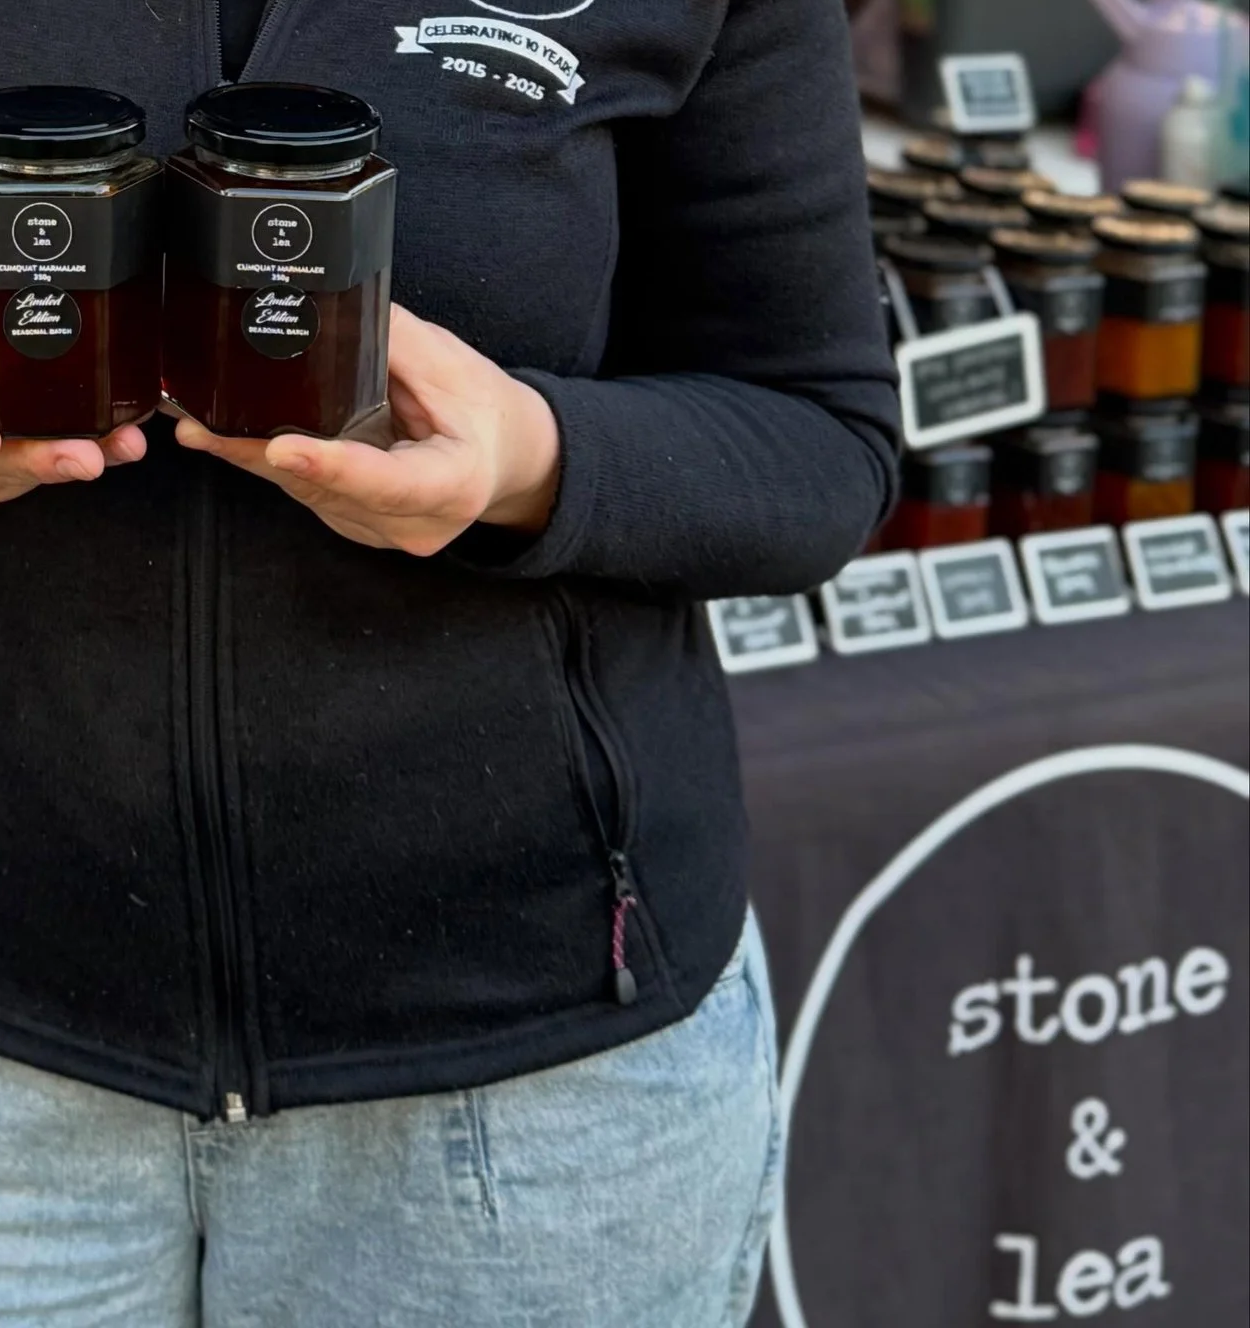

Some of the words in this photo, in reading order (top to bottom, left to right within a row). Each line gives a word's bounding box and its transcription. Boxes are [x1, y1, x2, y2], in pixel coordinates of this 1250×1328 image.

[424, 24, 523, 47] CELEBRATING
[524, 37, 540, 53] 10
[542, 44, 574, 77] YEARS
[441, 56, 488, 79] 2015
[504, 72, 546, 101] 2025
[27, 217, 58, 227] stone
[267, 217, 298, 228] stone
[33, 237, 52, 247] lea
[272, 237, 291, 247] lea
[38, 264, 87, 273] MARMALADE
[236, 263, 276, 273] CUMQUAT
[276, 265, 325, 275] MARMALADE
[15, 293, 66, 310] Limited
[254, 292, 306, 308] Limited
[17, 309, 61, 327] Edition
[255, 309, 299, 324] Edition
[11, 328, 48, 336] SEASONAL
[248, 326, 285, 335] SEASONAL
[948, 947, 1230, 1056] stone
[1066, 1098, 1126, 1180] &
[989, 1235, 1172, 1321] lea
